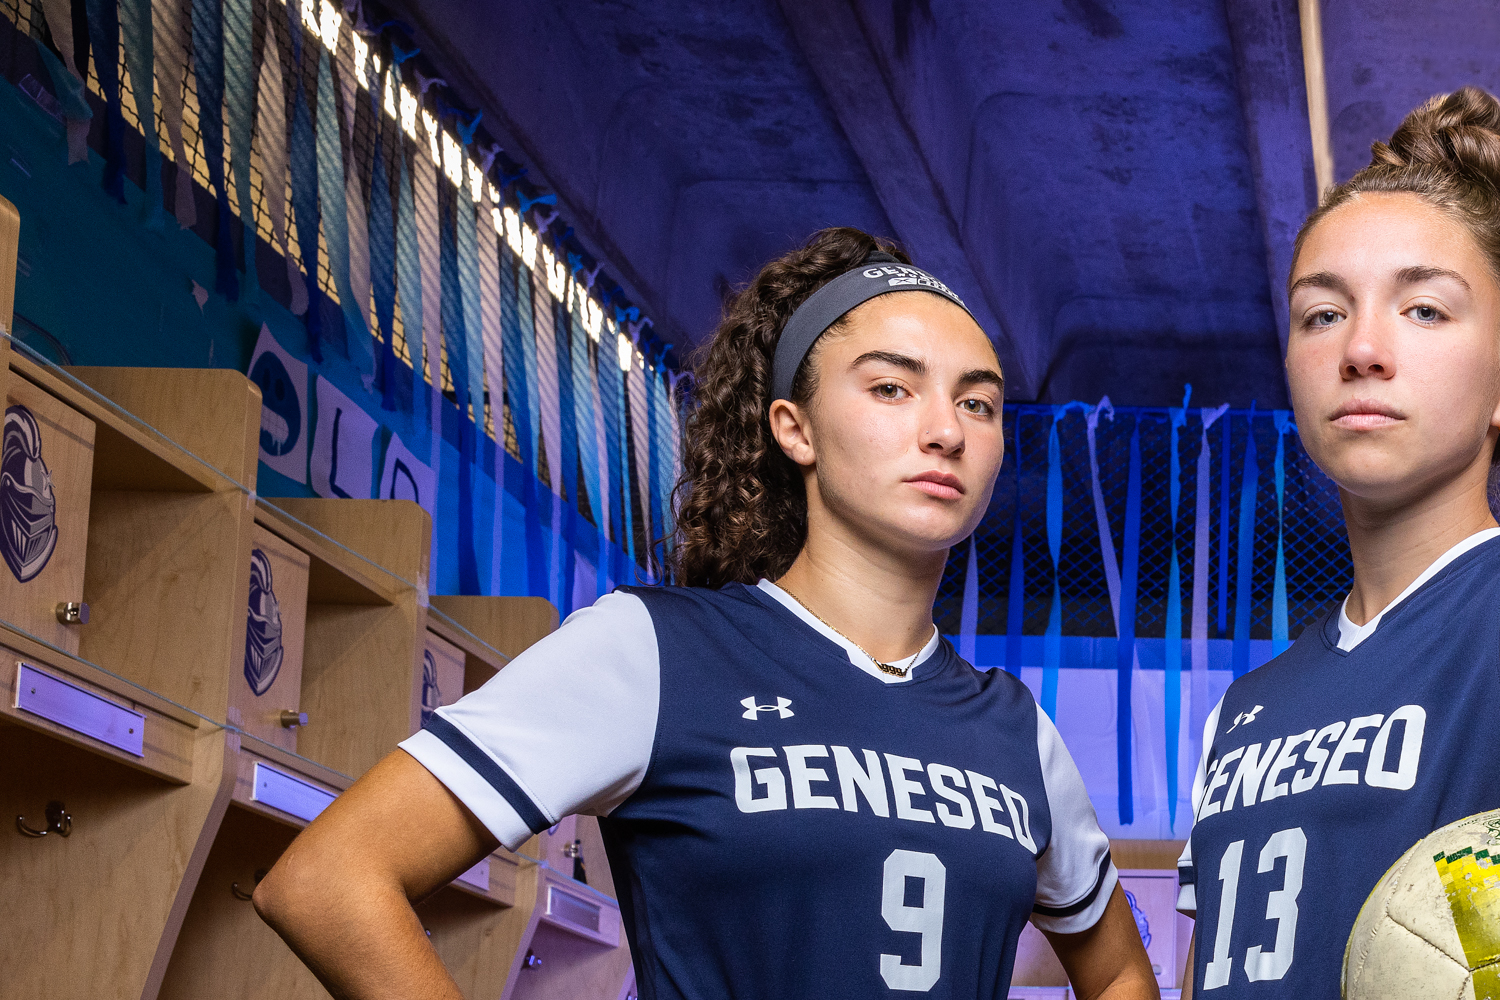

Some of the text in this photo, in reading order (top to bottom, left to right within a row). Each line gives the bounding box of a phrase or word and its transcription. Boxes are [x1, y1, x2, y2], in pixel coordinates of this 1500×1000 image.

[730, 744, 1038, 855] GENESEO
[879, 848, 947, 992] 9
[1203, 827, 1308, 991] 13
